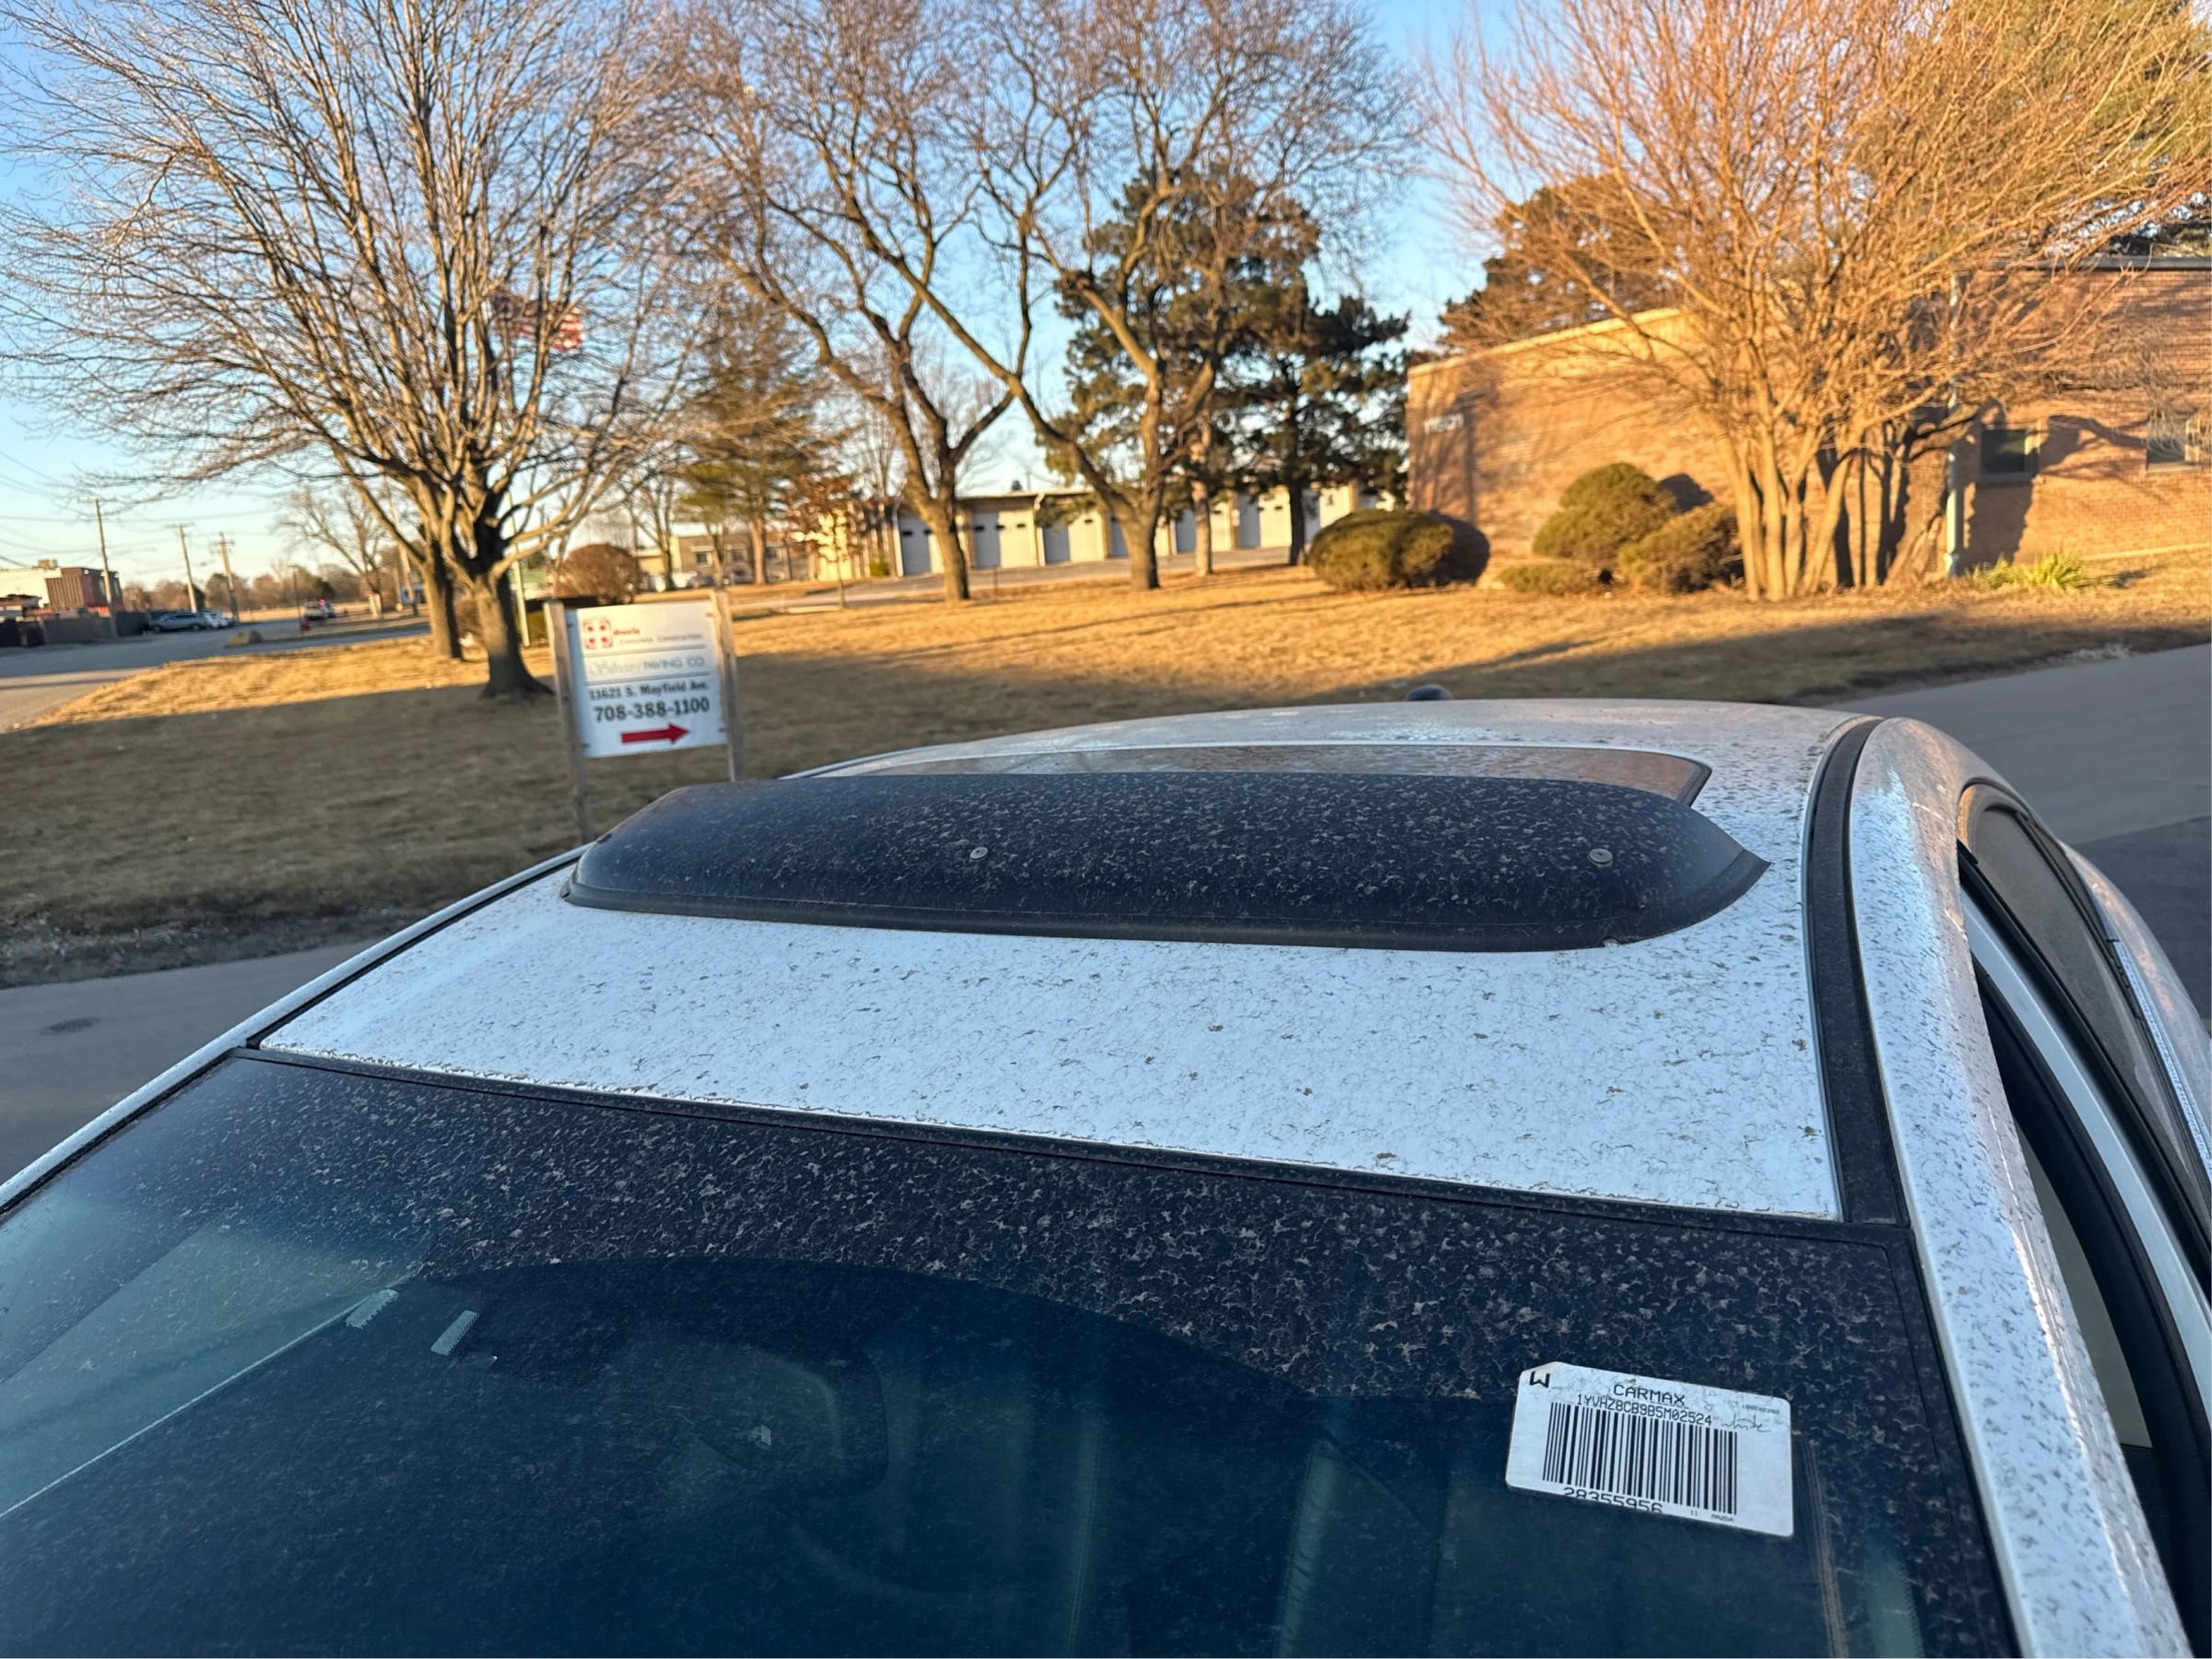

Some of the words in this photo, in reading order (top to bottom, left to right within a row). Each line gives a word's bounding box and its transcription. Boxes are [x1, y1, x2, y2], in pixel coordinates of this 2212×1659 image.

[641, 681, 687, 697] Mayfield
[690, 678, 710, 691] Ave.
[594, 696, 710, 723] 708-388-1100
[1613, 1383, 1686, 1406] CARMAX
